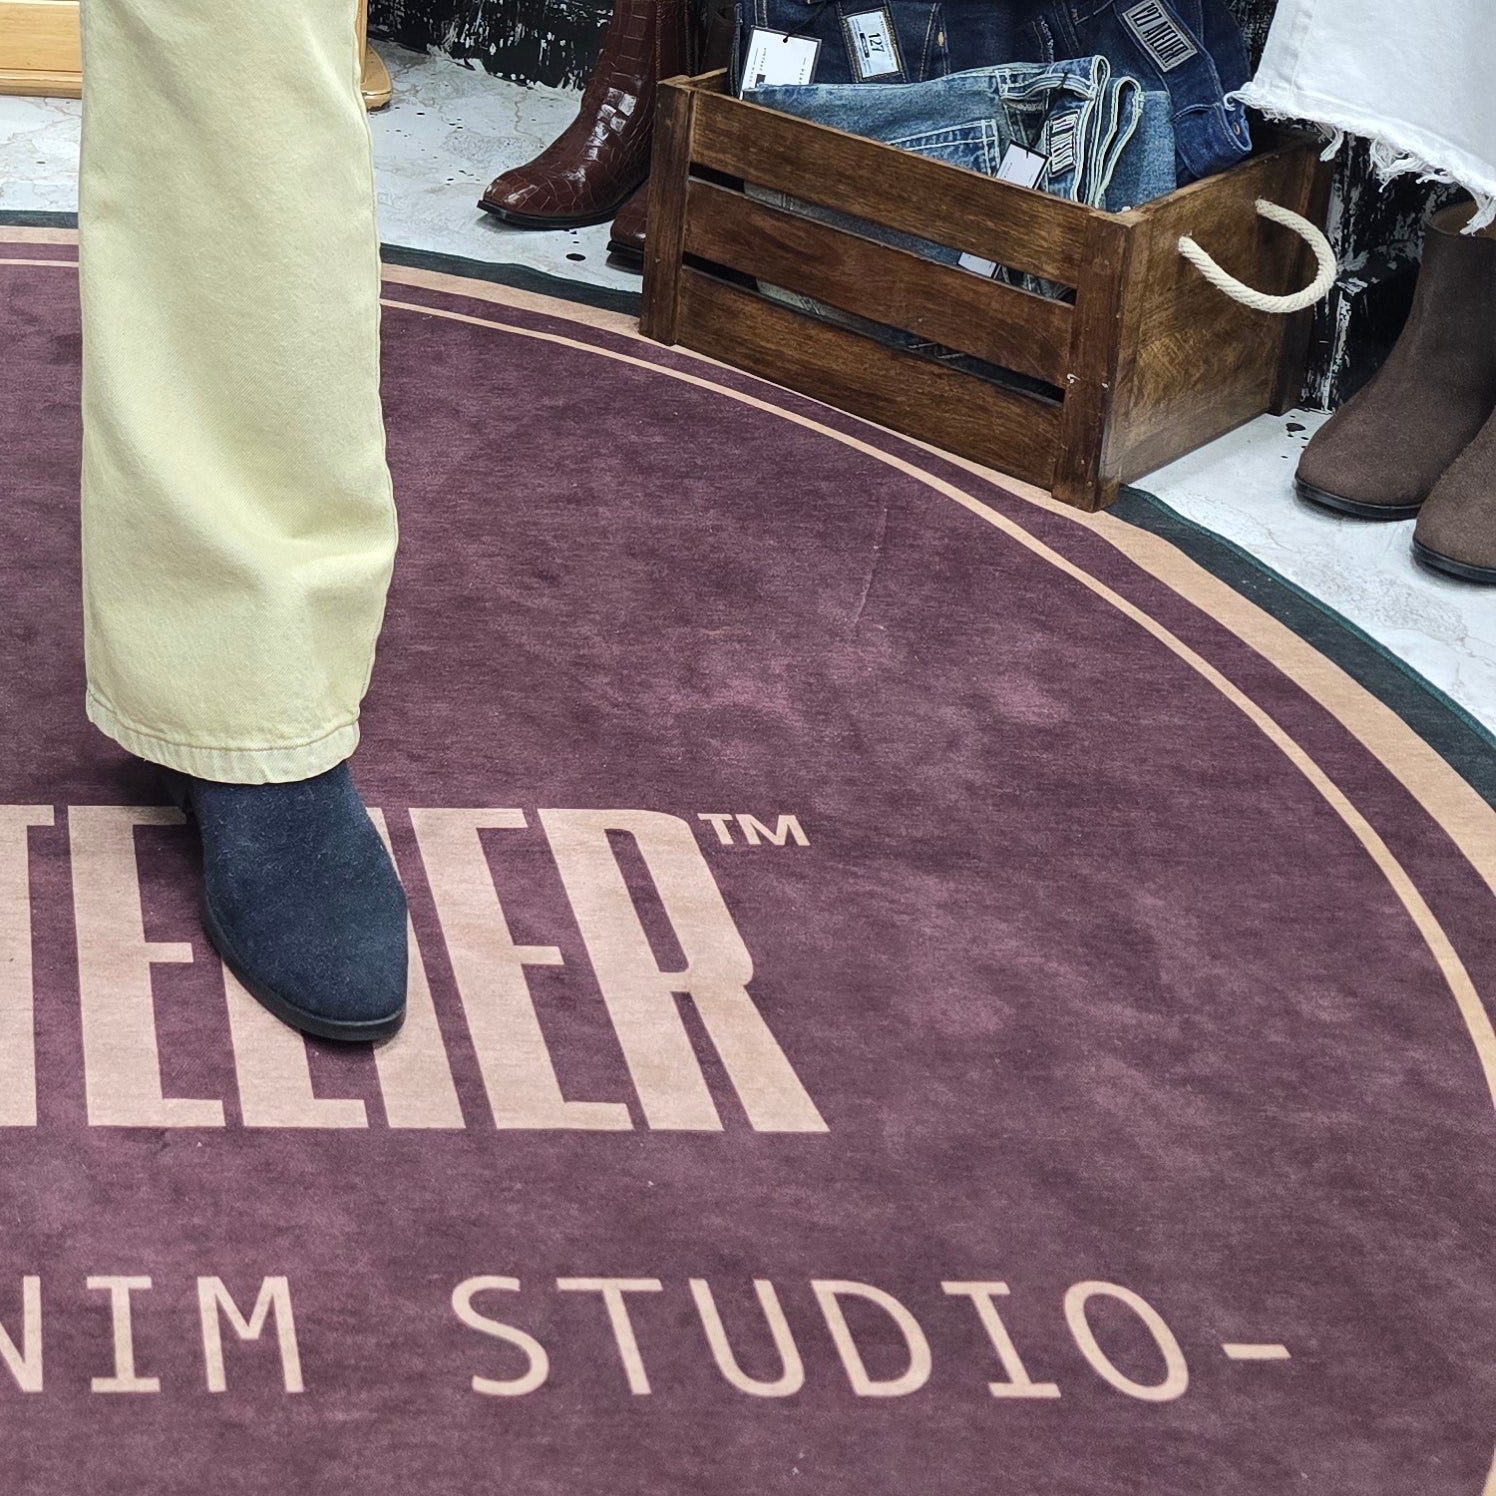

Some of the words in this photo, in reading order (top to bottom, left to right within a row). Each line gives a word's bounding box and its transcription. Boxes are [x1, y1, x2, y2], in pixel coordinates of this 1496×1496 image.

[1131, 2, 1163, 27] 127
[868, 32, 885, 53] 127
[1142, 20, 1189, 64] ATELIER
